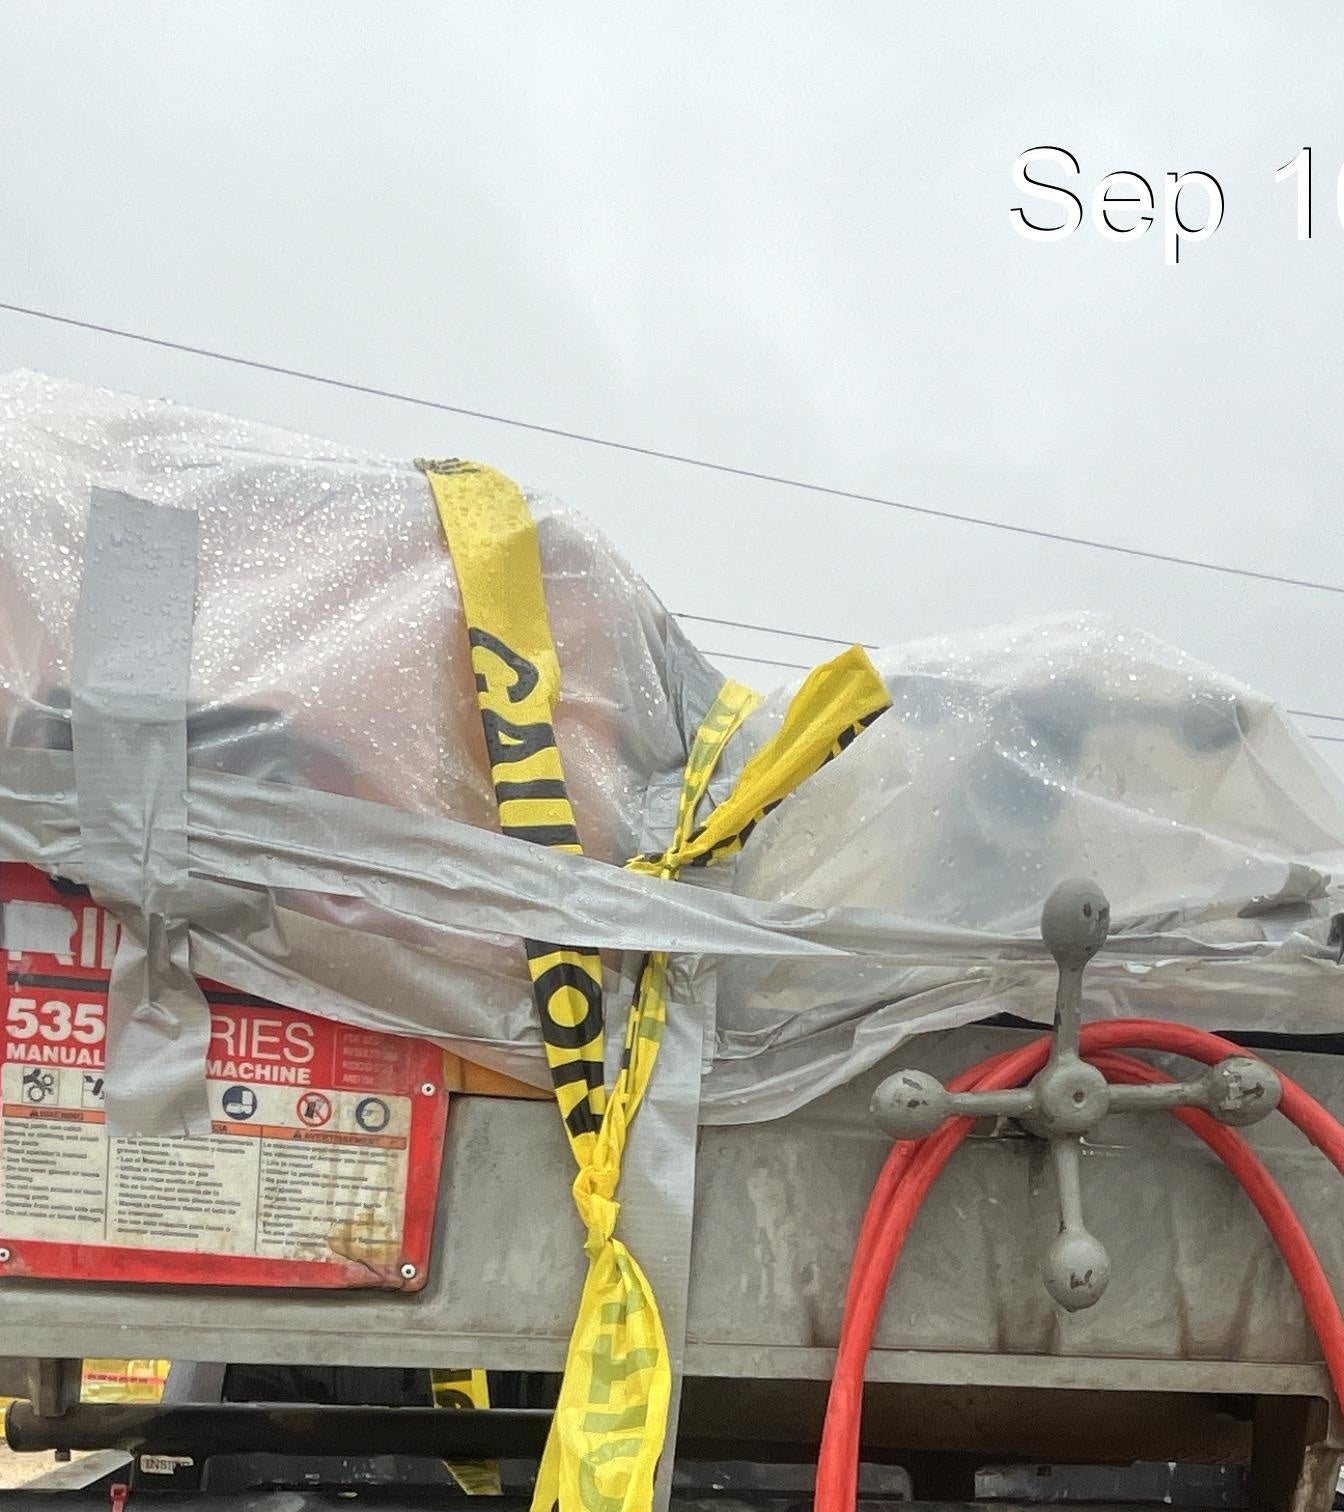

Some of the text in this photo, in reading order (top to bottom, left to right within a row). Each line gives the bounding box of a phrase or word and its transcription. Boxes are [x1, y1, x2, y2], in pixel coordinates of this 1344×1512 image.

[5, 997, 106, 1044] 535
[210, 1014, 315, 1064] RIES
[6, 1042, 105, 1066] MANUAL
[205, 1058, 312, 1085] MACHINE
